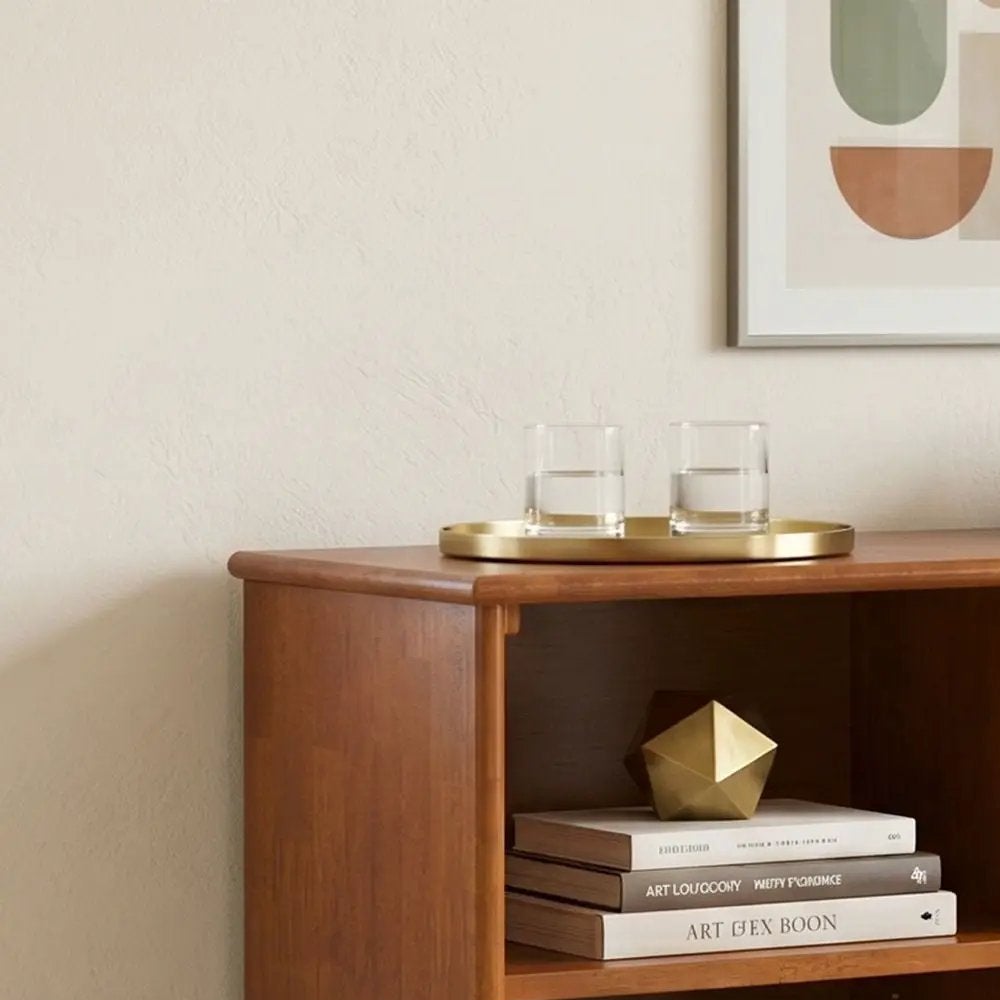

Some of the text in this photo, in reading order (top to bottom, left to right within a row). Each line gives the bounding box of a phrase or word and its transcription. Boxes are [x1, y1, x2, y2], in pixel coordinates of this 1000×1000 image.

[646, 885, 670, 896] ART
[686, 922, 724, 940] ART
[780, 914, 836, 934] BOON
